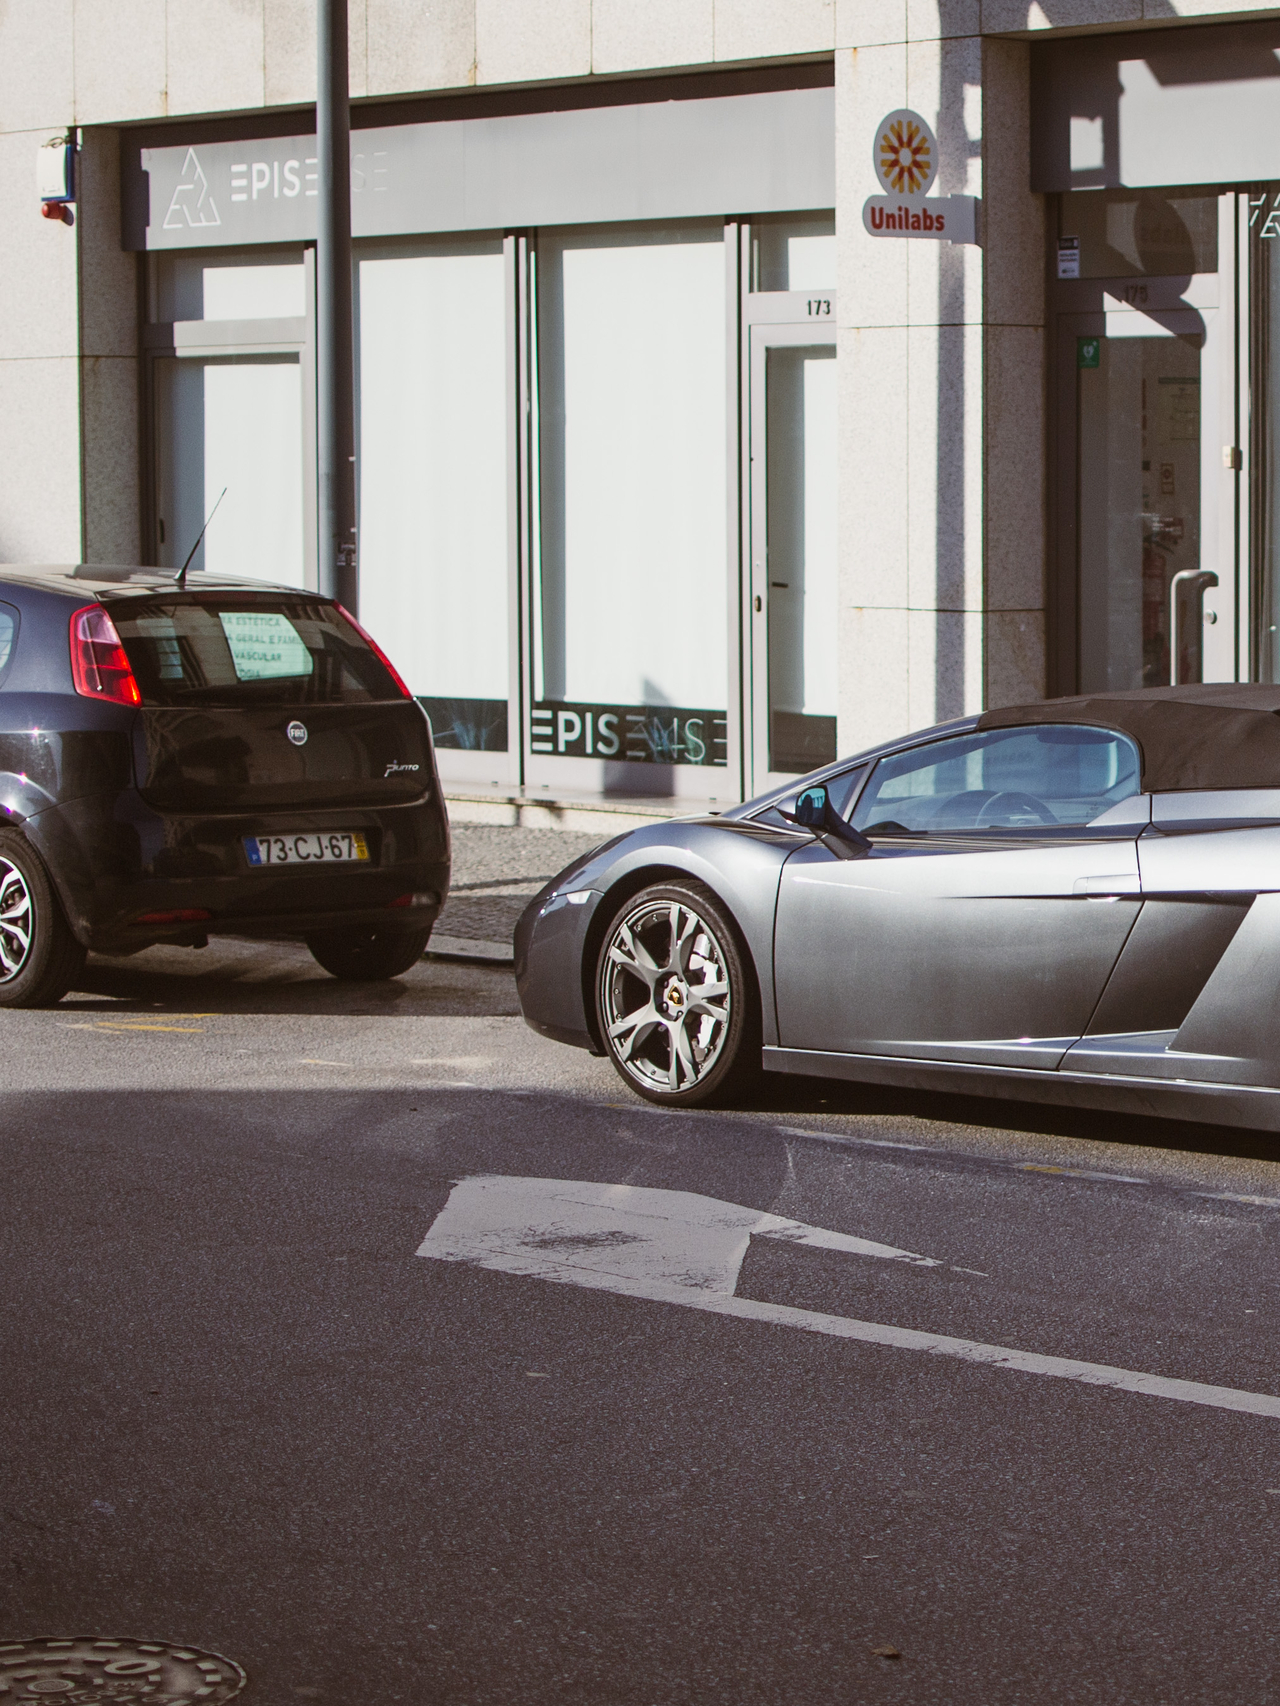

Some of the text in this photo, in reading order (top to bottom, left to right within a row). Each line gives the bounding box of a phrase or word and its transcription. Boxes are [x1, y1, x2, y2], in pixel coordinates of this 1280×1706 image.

[231, 151, 388, 202] EPISESE
[870, 205, 945, 231] Unilabs
[806, 299, 831, 315] 173
[234, 651, 282, 662] VASCULAR
[290, 728, 305, 738] FIAT
